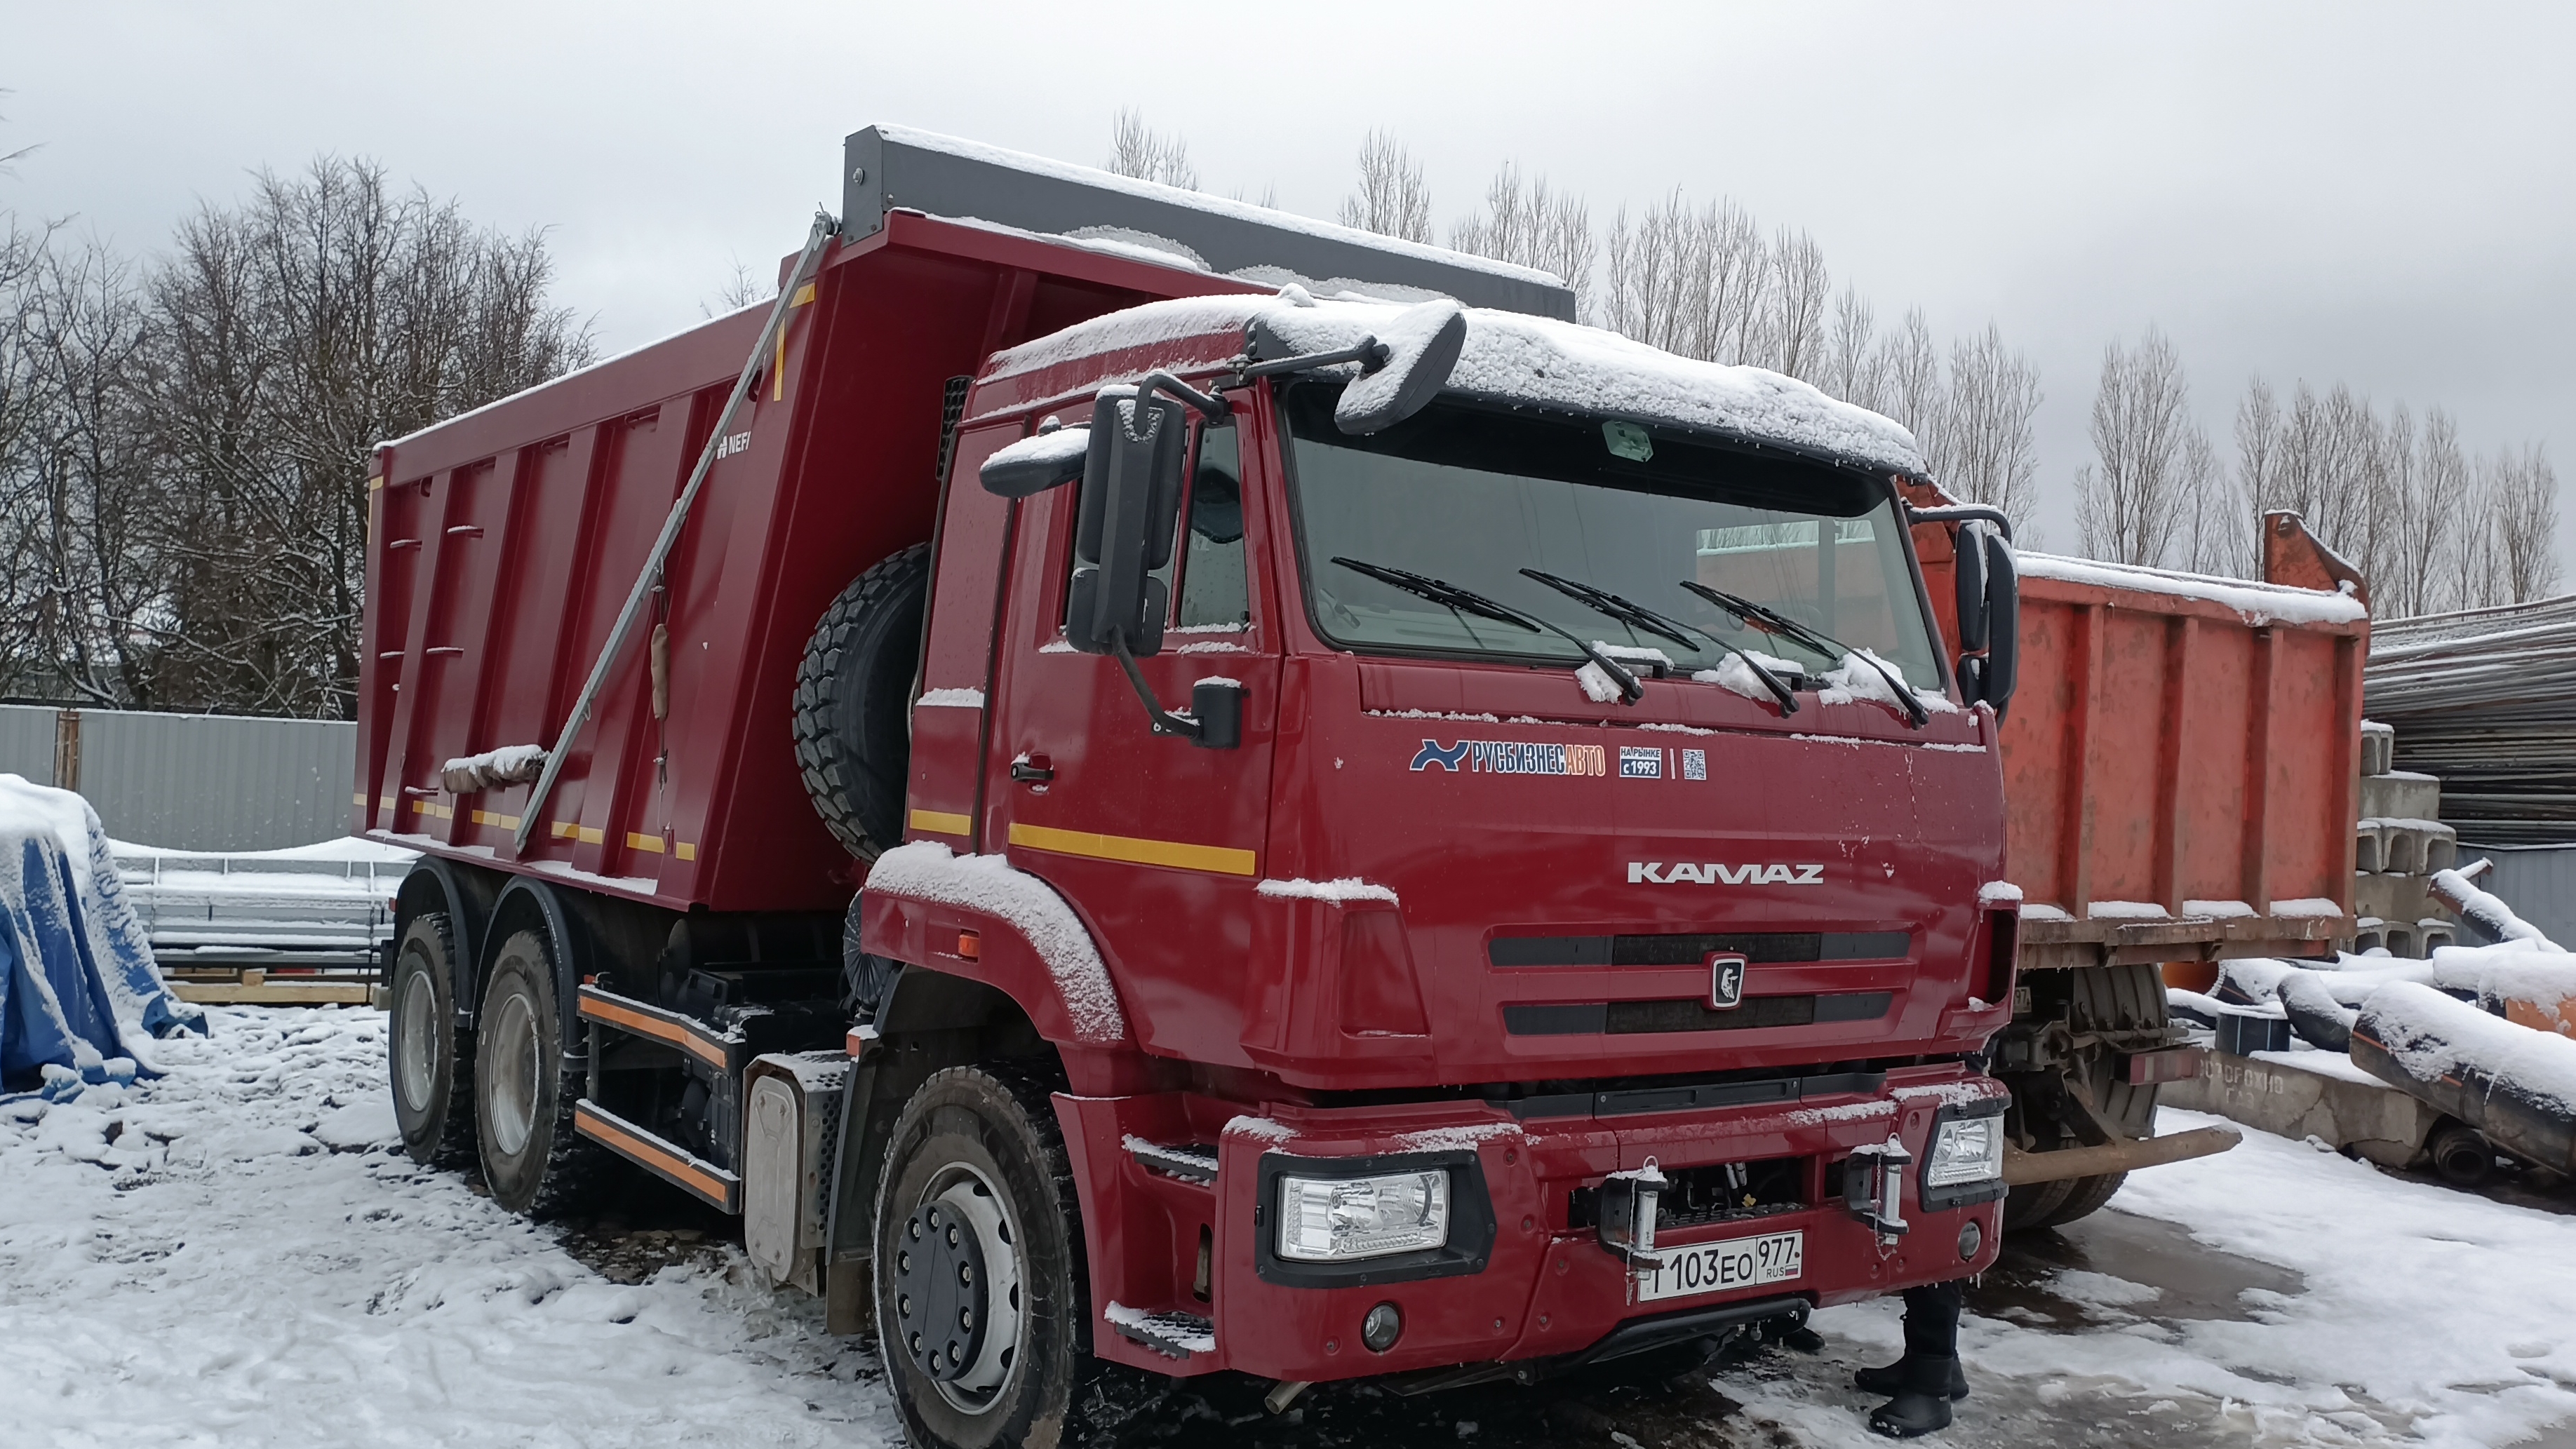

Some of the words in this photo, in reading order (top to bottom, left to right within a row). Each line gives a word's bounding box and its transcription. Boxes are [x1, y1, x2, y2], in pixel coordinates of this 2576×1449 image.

[1472, 741, 1606, 776] РУСБИЗНЕСАВТО
[1621, 748, 1631, 757] НА
[1633, 748, 1661, 757] РЫНКЕ
[1628, 862, 1823, 884] KAMAZ
[1758, 1236, 1795, 1267] 977
[1766, 1267, 1785, 1279] RUS
